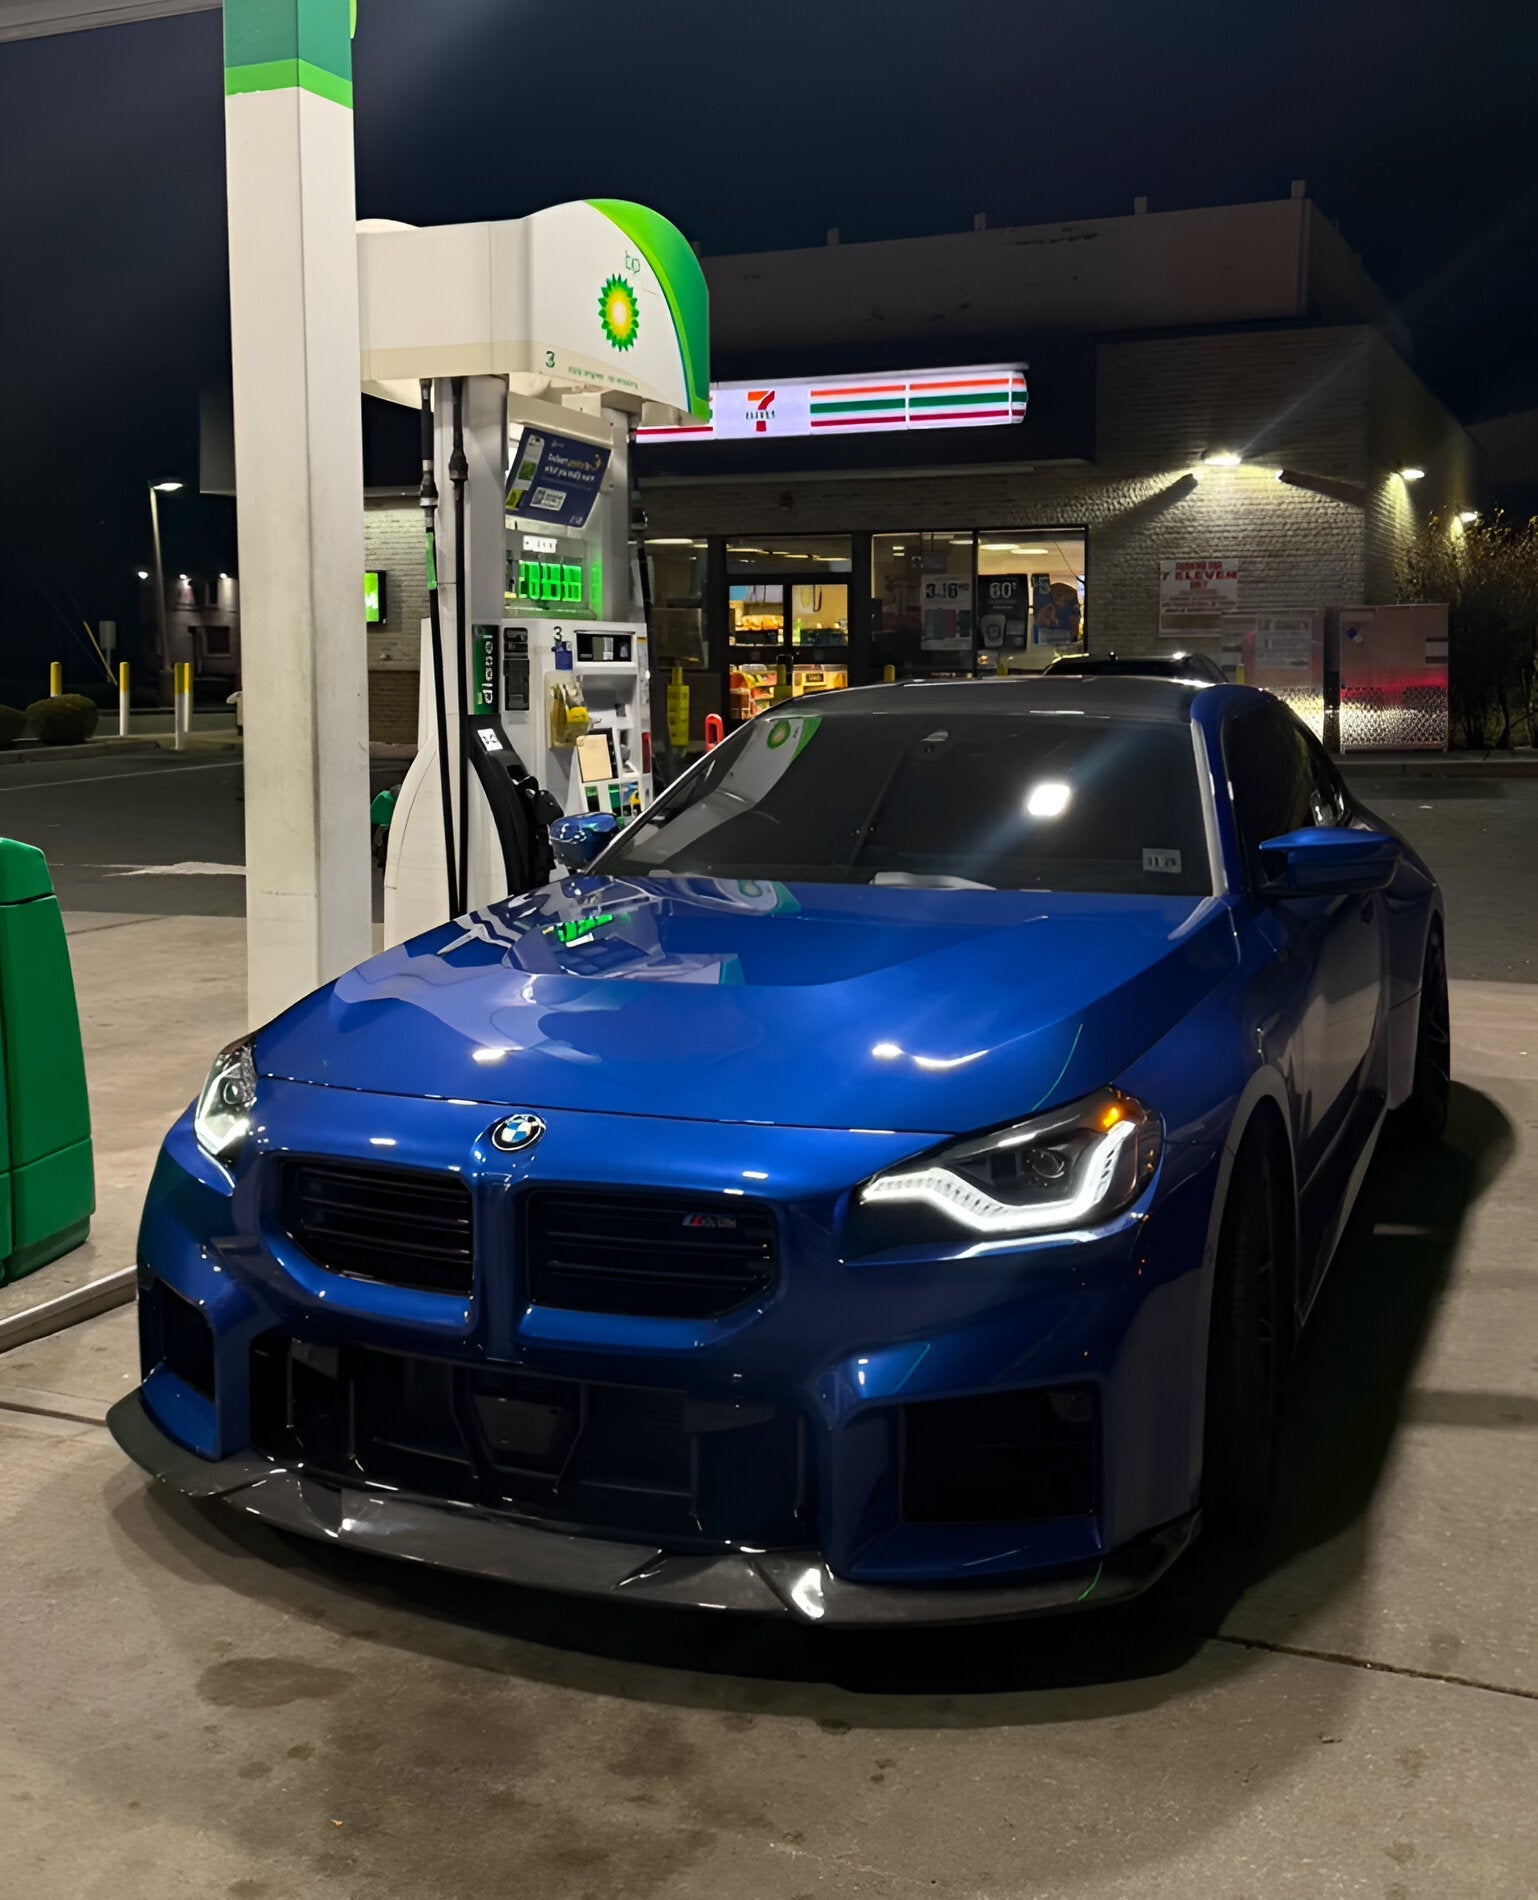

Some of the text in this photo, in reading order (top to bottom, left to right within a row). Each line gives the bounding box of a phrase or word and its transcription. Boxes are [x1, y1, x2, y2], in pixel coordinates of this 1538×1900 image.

[625, 250, 640, 275] bp
[545, 350, 555, 368] 3
[747, 390, 775, 432] 7
[553, 626, 563, 642] 3
[481, 634, 494, 704] diesel
